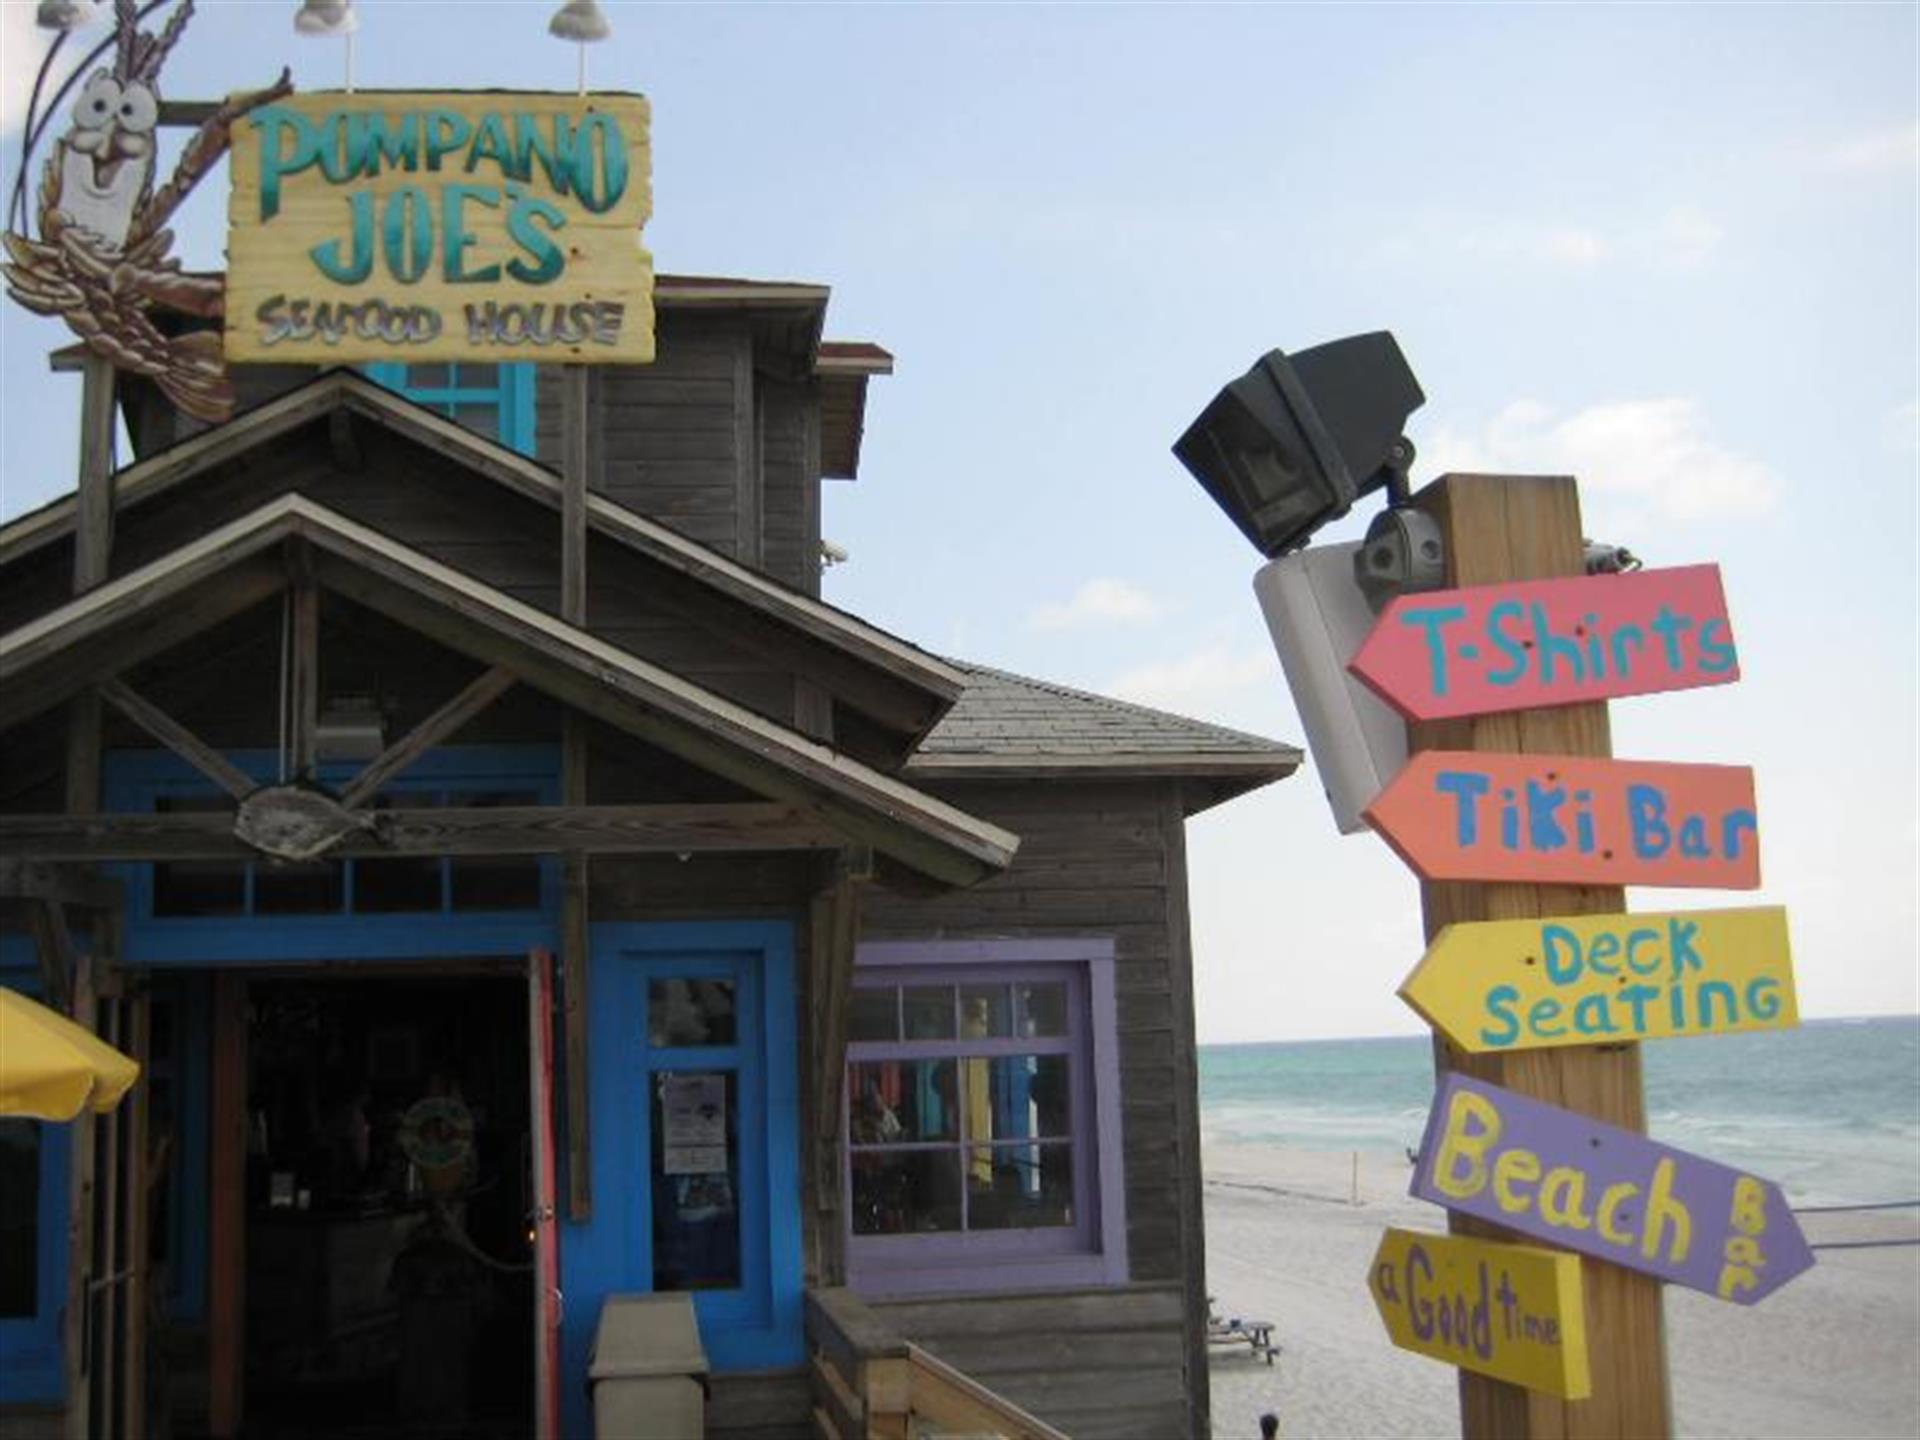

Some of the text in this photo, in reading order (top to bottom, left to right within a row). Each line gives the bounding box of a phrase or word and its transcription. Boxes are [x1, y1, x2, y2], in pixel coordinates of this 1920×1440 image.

[250, 106, 629, 223] POMPANO
[309, 182, 566, 285] JOE'S
[256, 294, 625, 346] SEAFOOD HOUSE
[1401, 601, 1737, 696] T-Shirts
[1626, 784, 1757, 861] Bar
[1433, 1090, 1692, 1264] Beach
[1378, 1262, 1399, 1304] a
[1406, 1243, 1493, 1361] Good
